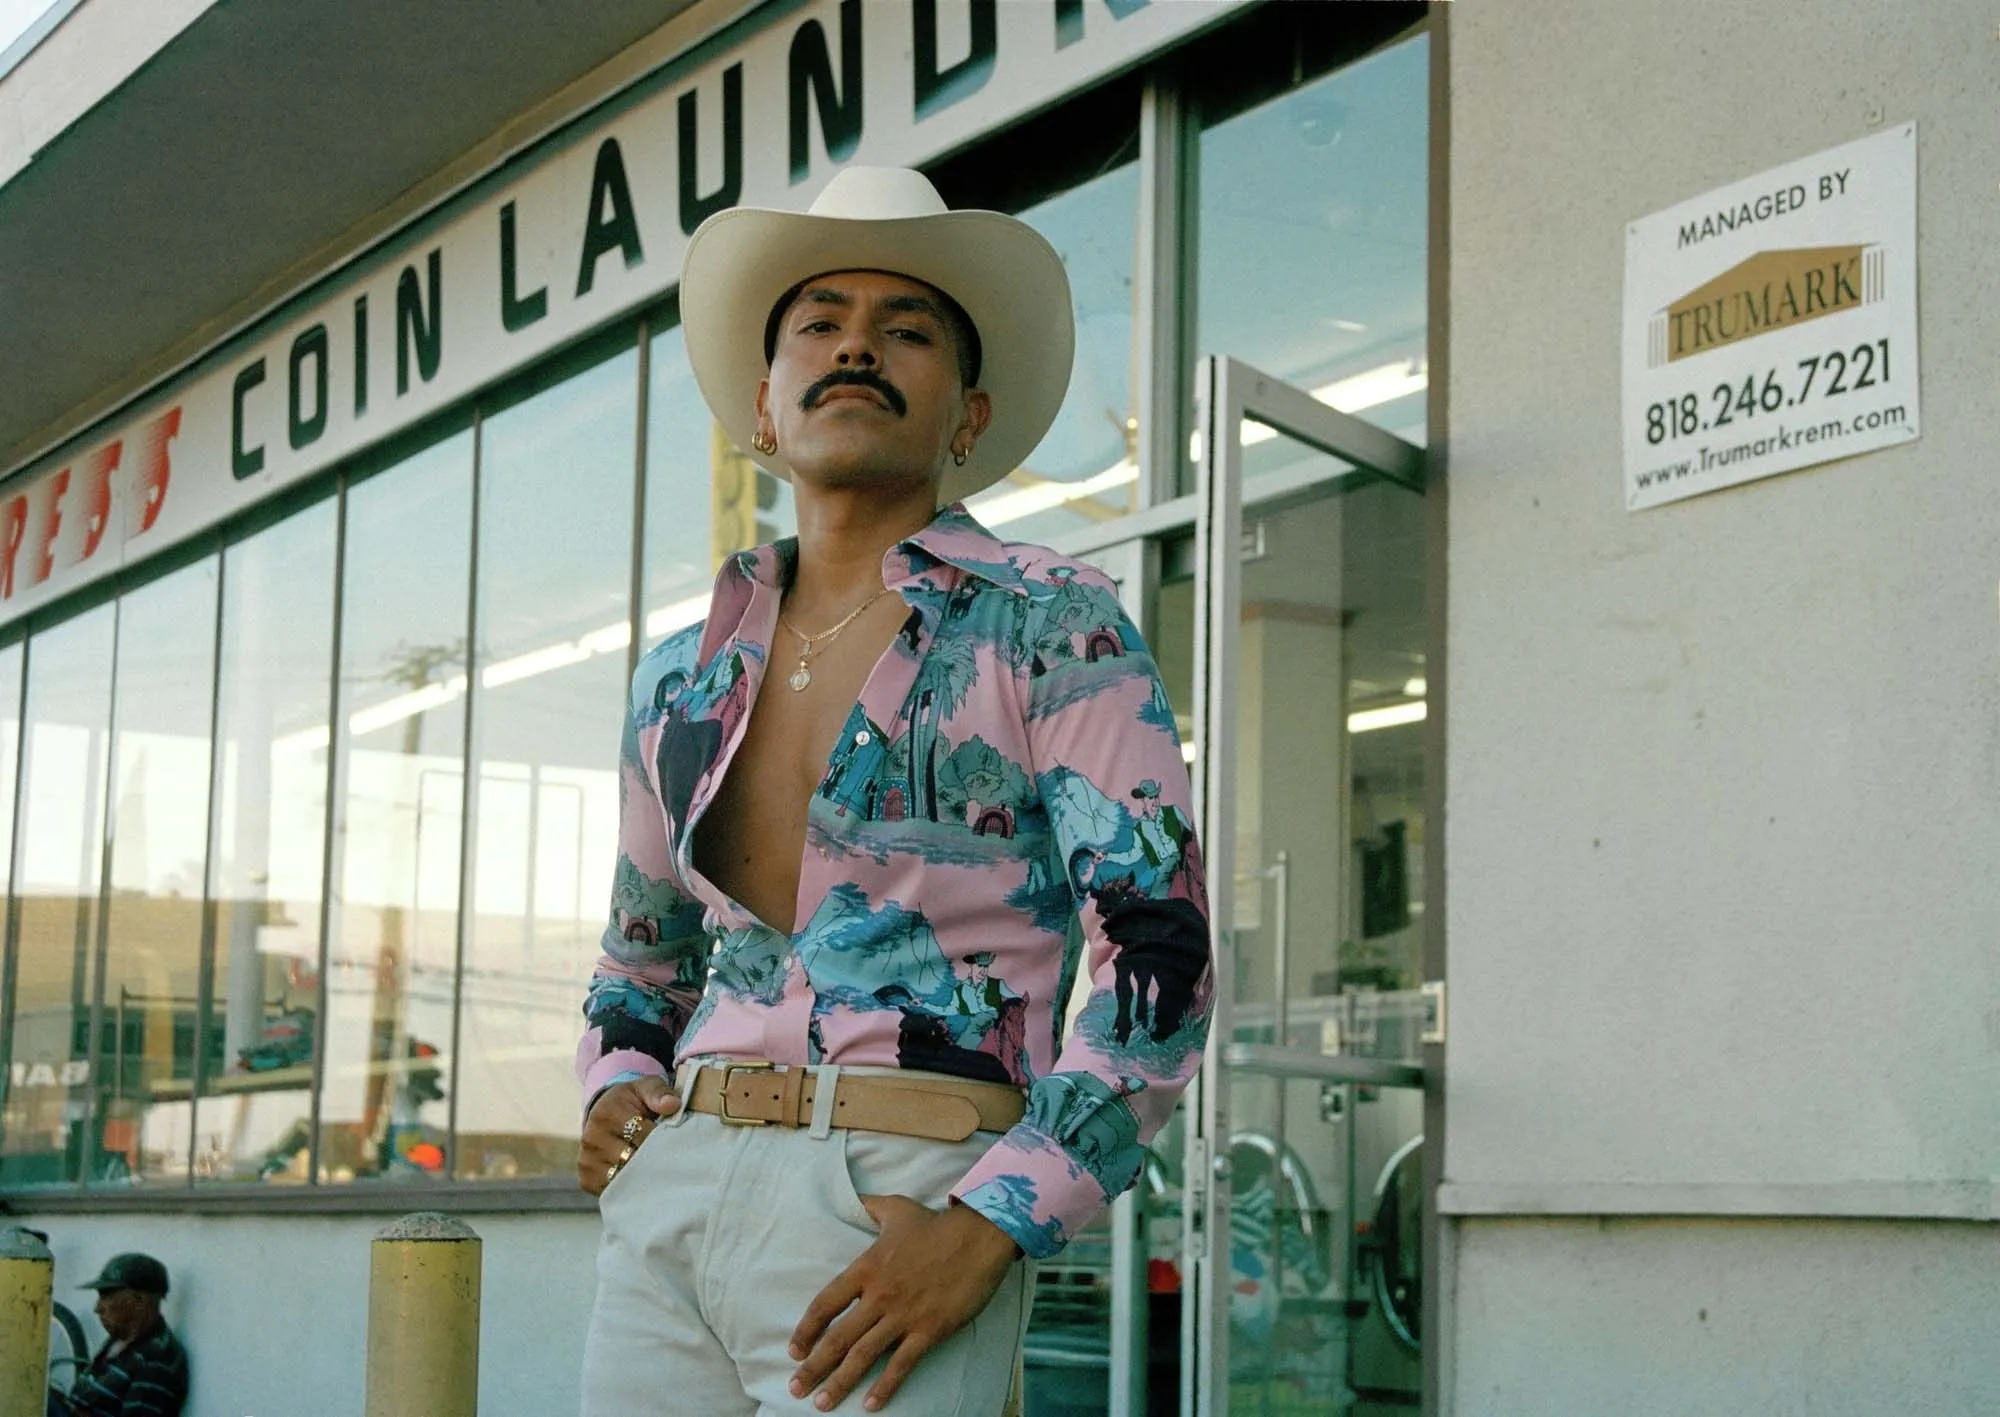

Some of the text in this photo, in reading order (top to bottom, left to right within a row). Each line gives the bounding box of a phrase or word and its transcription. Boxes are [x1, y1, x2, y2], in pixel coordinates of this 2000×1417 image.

[1677, 168, 1852, 248] MANAGED BY
[1670, 257, 1860, 354] TRUMARK
[231, 246, 441, 482] COIN
[1646, 338, 1891, 445] 818.246.7221
[1636, 405, 1906, 489] www.Trumarkrem.com
